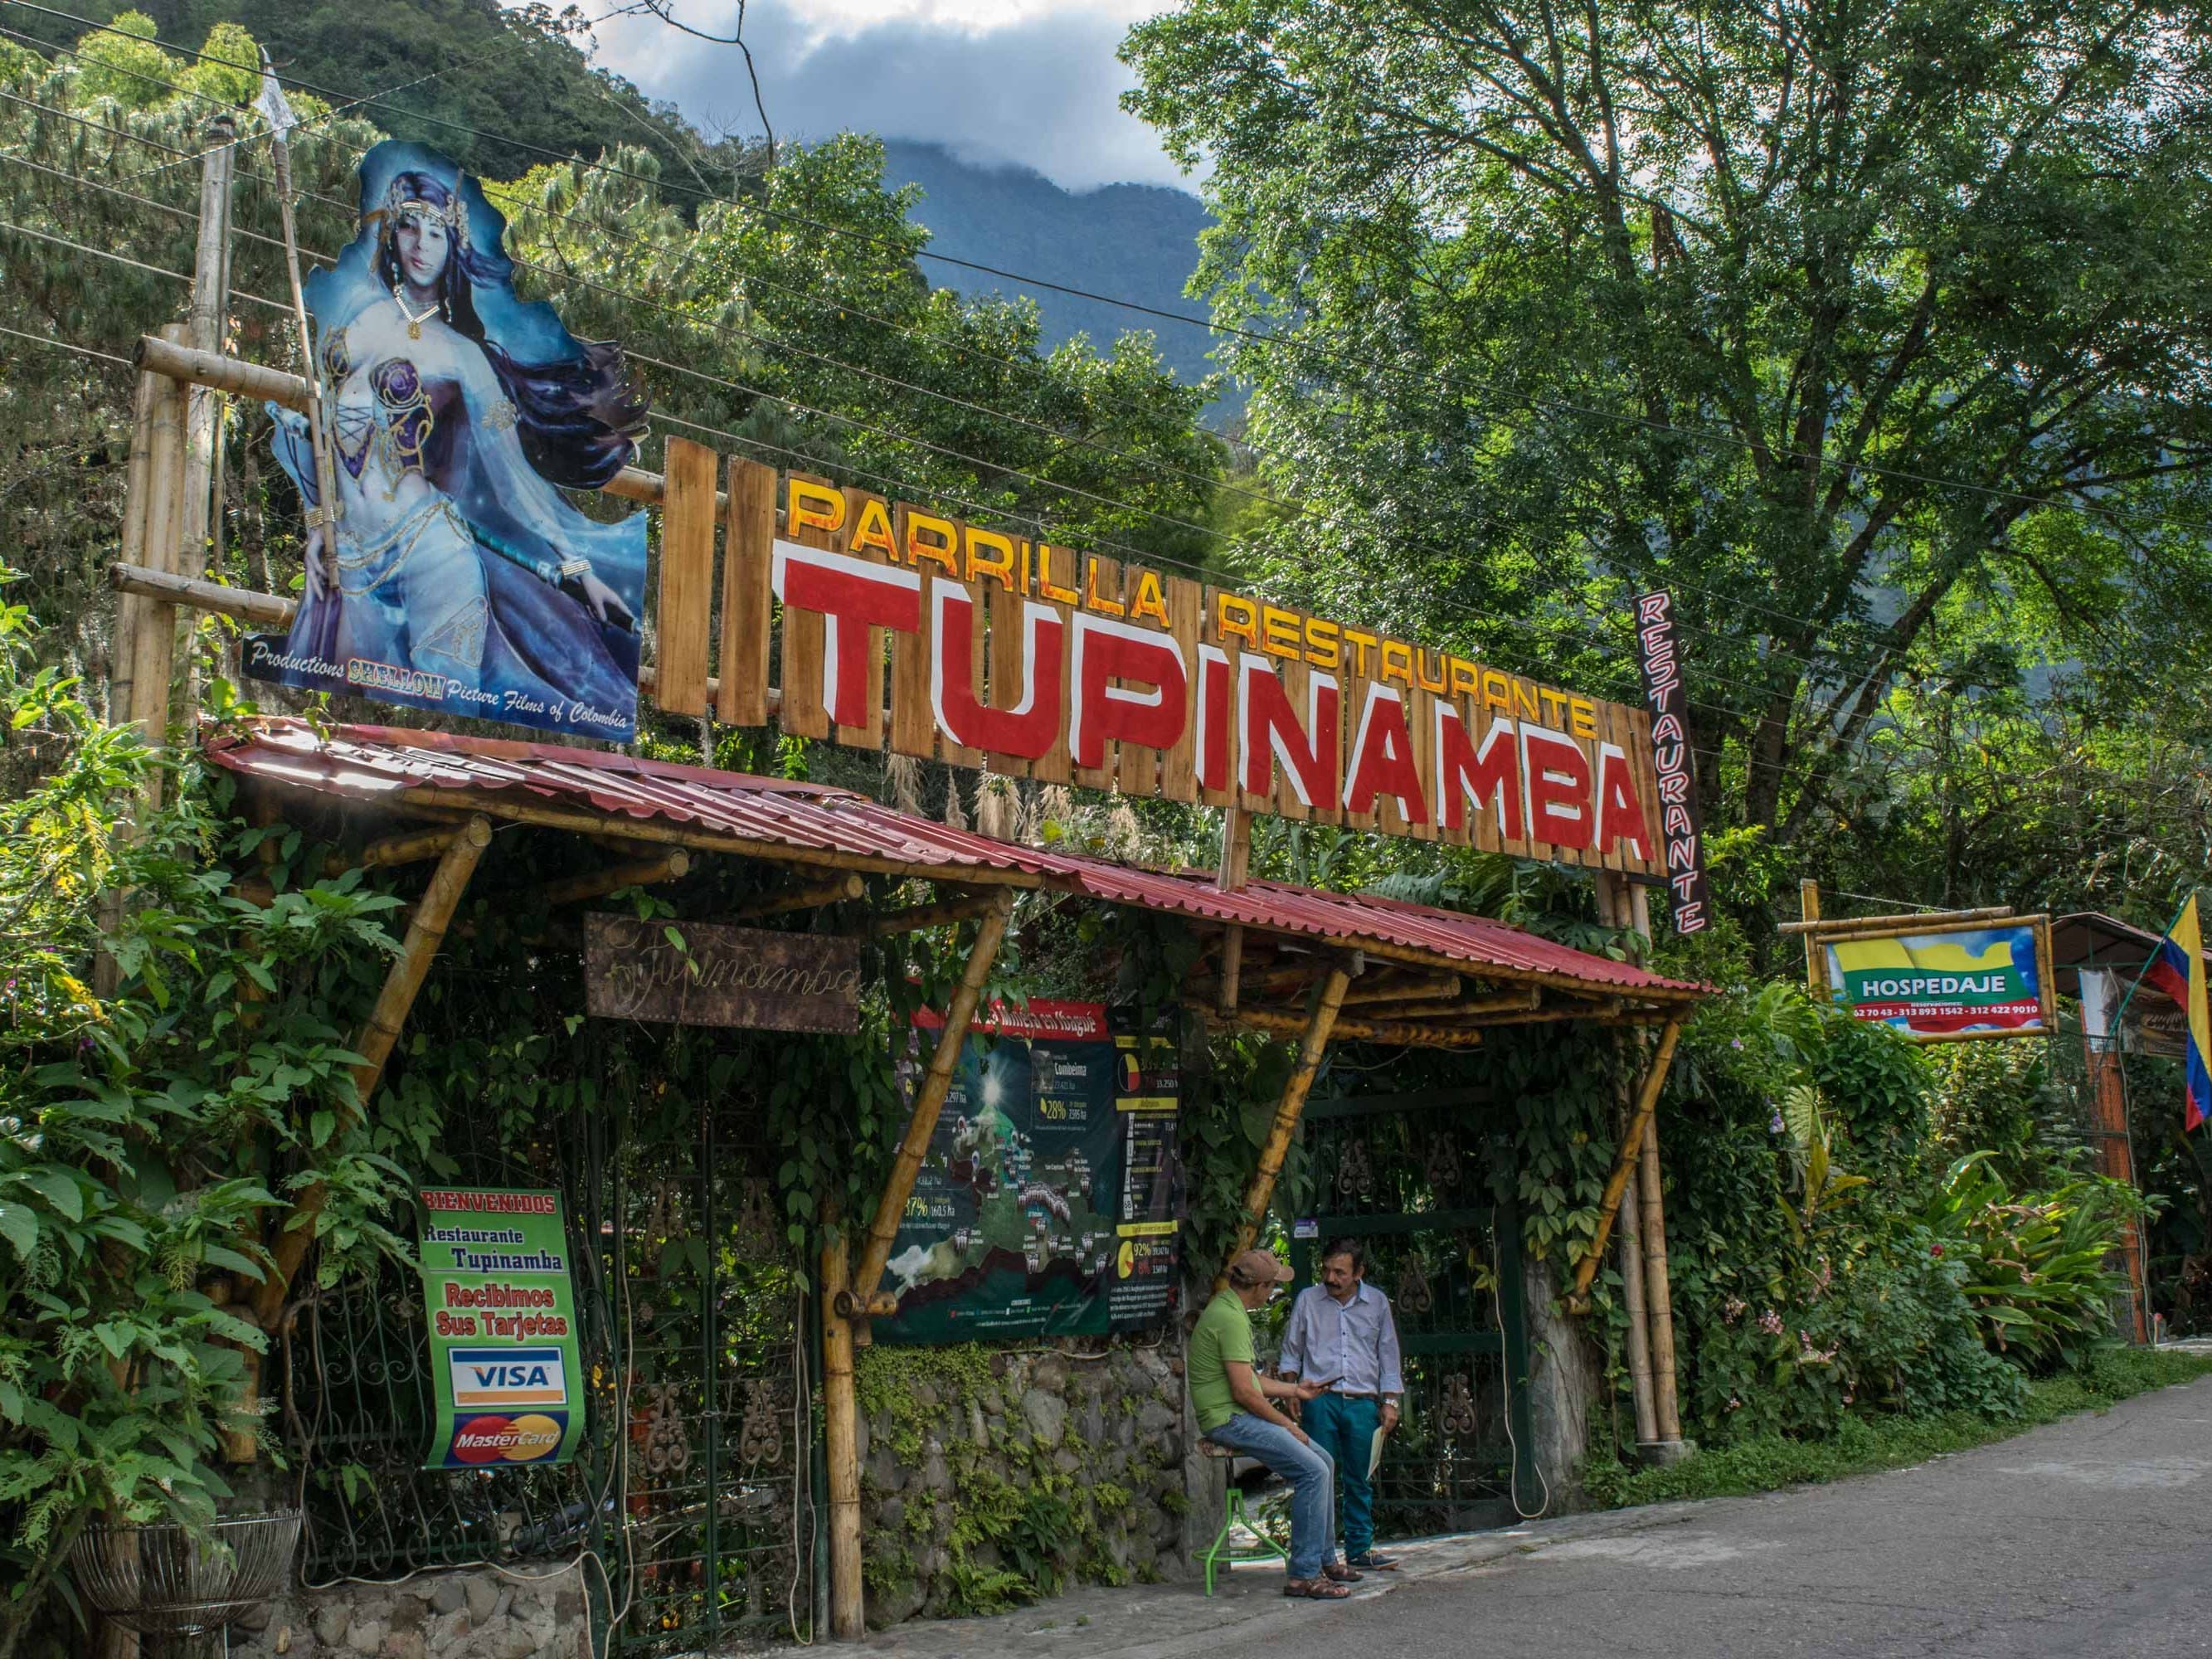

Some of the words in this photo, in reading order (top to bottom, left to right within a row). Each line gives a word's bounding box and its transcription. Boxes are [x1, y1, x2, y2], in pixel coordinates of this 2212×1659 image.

[787, 478, 1171, 628] PARRILLA
[1217, 592, 1597, 740] RESTAURANTE
[251, 641, 345, 678] Productions
[447, 679, 499, 705] Picture
[504, 690, 545, 712] Films
[549, 701, 564, 722] of
[569, 702, 627, 729] Colombia
[772, 538, 1655, 862] TUPINAMBA
[1639, 591, 1705, 934] RESTAURANTE
[1863, 975, 2006, 997] HOSPEDAJE
[1898, 1008, 1918, 1016] 313
[1918, 1008, 1937, 1016] 893
[1939, 1007, 1963, 1015] 1542
[1970, 1006, 1989, 1014] 312
[2012, 1005, 2038, 1014] 9010
[1040, 1014, 1058, 1029] en
[1055, 1010, 1096, 1037] Ibagué
[1047, 1100, 1067, 1120] 28%
[420, 1190, 557, 1214] BIENVENIDOS
[424, 1224, 524, 1243] Restaurante
[451, 1247, 563, 1273] Tupinamba
[1133, 1243, 1151, 1257] 92%
[445, 1282, 555, 1308] Recibimos
[435, 1311, 476, 1336] Sus
[480, 1311, 568, 1341] Tarjetas
[473, 1365, 550, 1388] VISA
[455, 1429, 558, 1448] MasterCard
